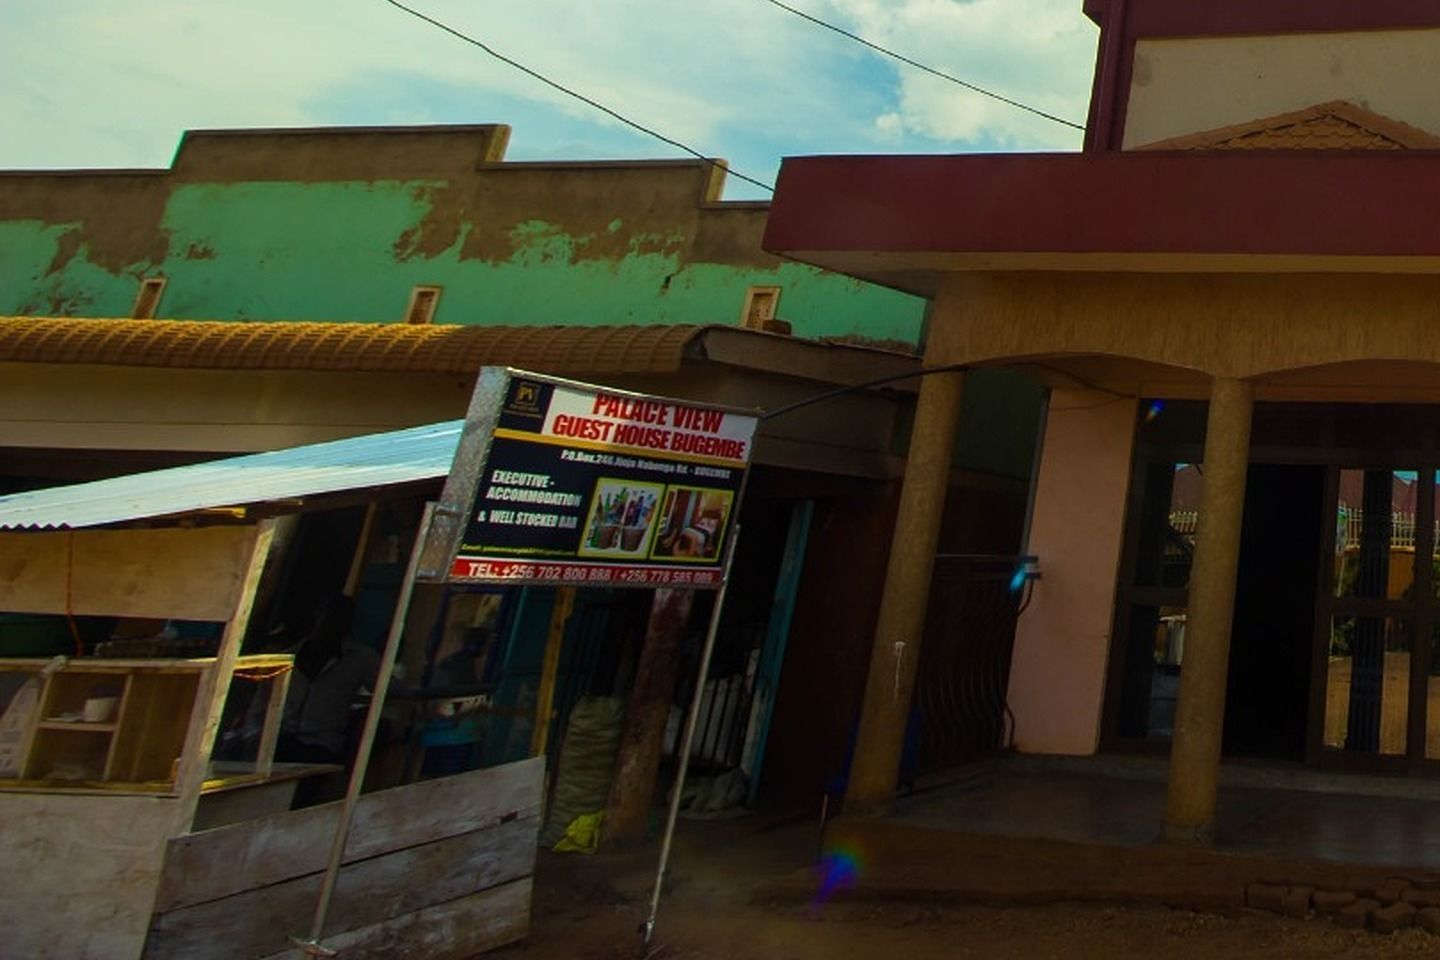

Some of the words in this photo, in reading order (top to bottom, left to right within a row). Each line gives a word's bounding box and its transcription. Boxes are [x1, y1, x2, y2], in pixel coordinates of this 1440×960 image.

[593, 392, 669, 426] PALACE
[673, 405, 725, 434] VIEW
[552, 413, 613, 441] GUEST
[613, 421, 671, 450] HOUSE
[670, 430, 746, 459] BUGEMBE
[491, 469, 550, 488] EXECUTIVE
[486, 486, 582, 507] ACCOMMODATION
[477, 510, 487, 522] &
[490, 510, 515, 524] WELL
[515, 511, 559, 528] STOCKED
[468, 562, 498, 579] TEL:
[501, 564, 535, 579] +256
[535, 565, 561, 579] 702
